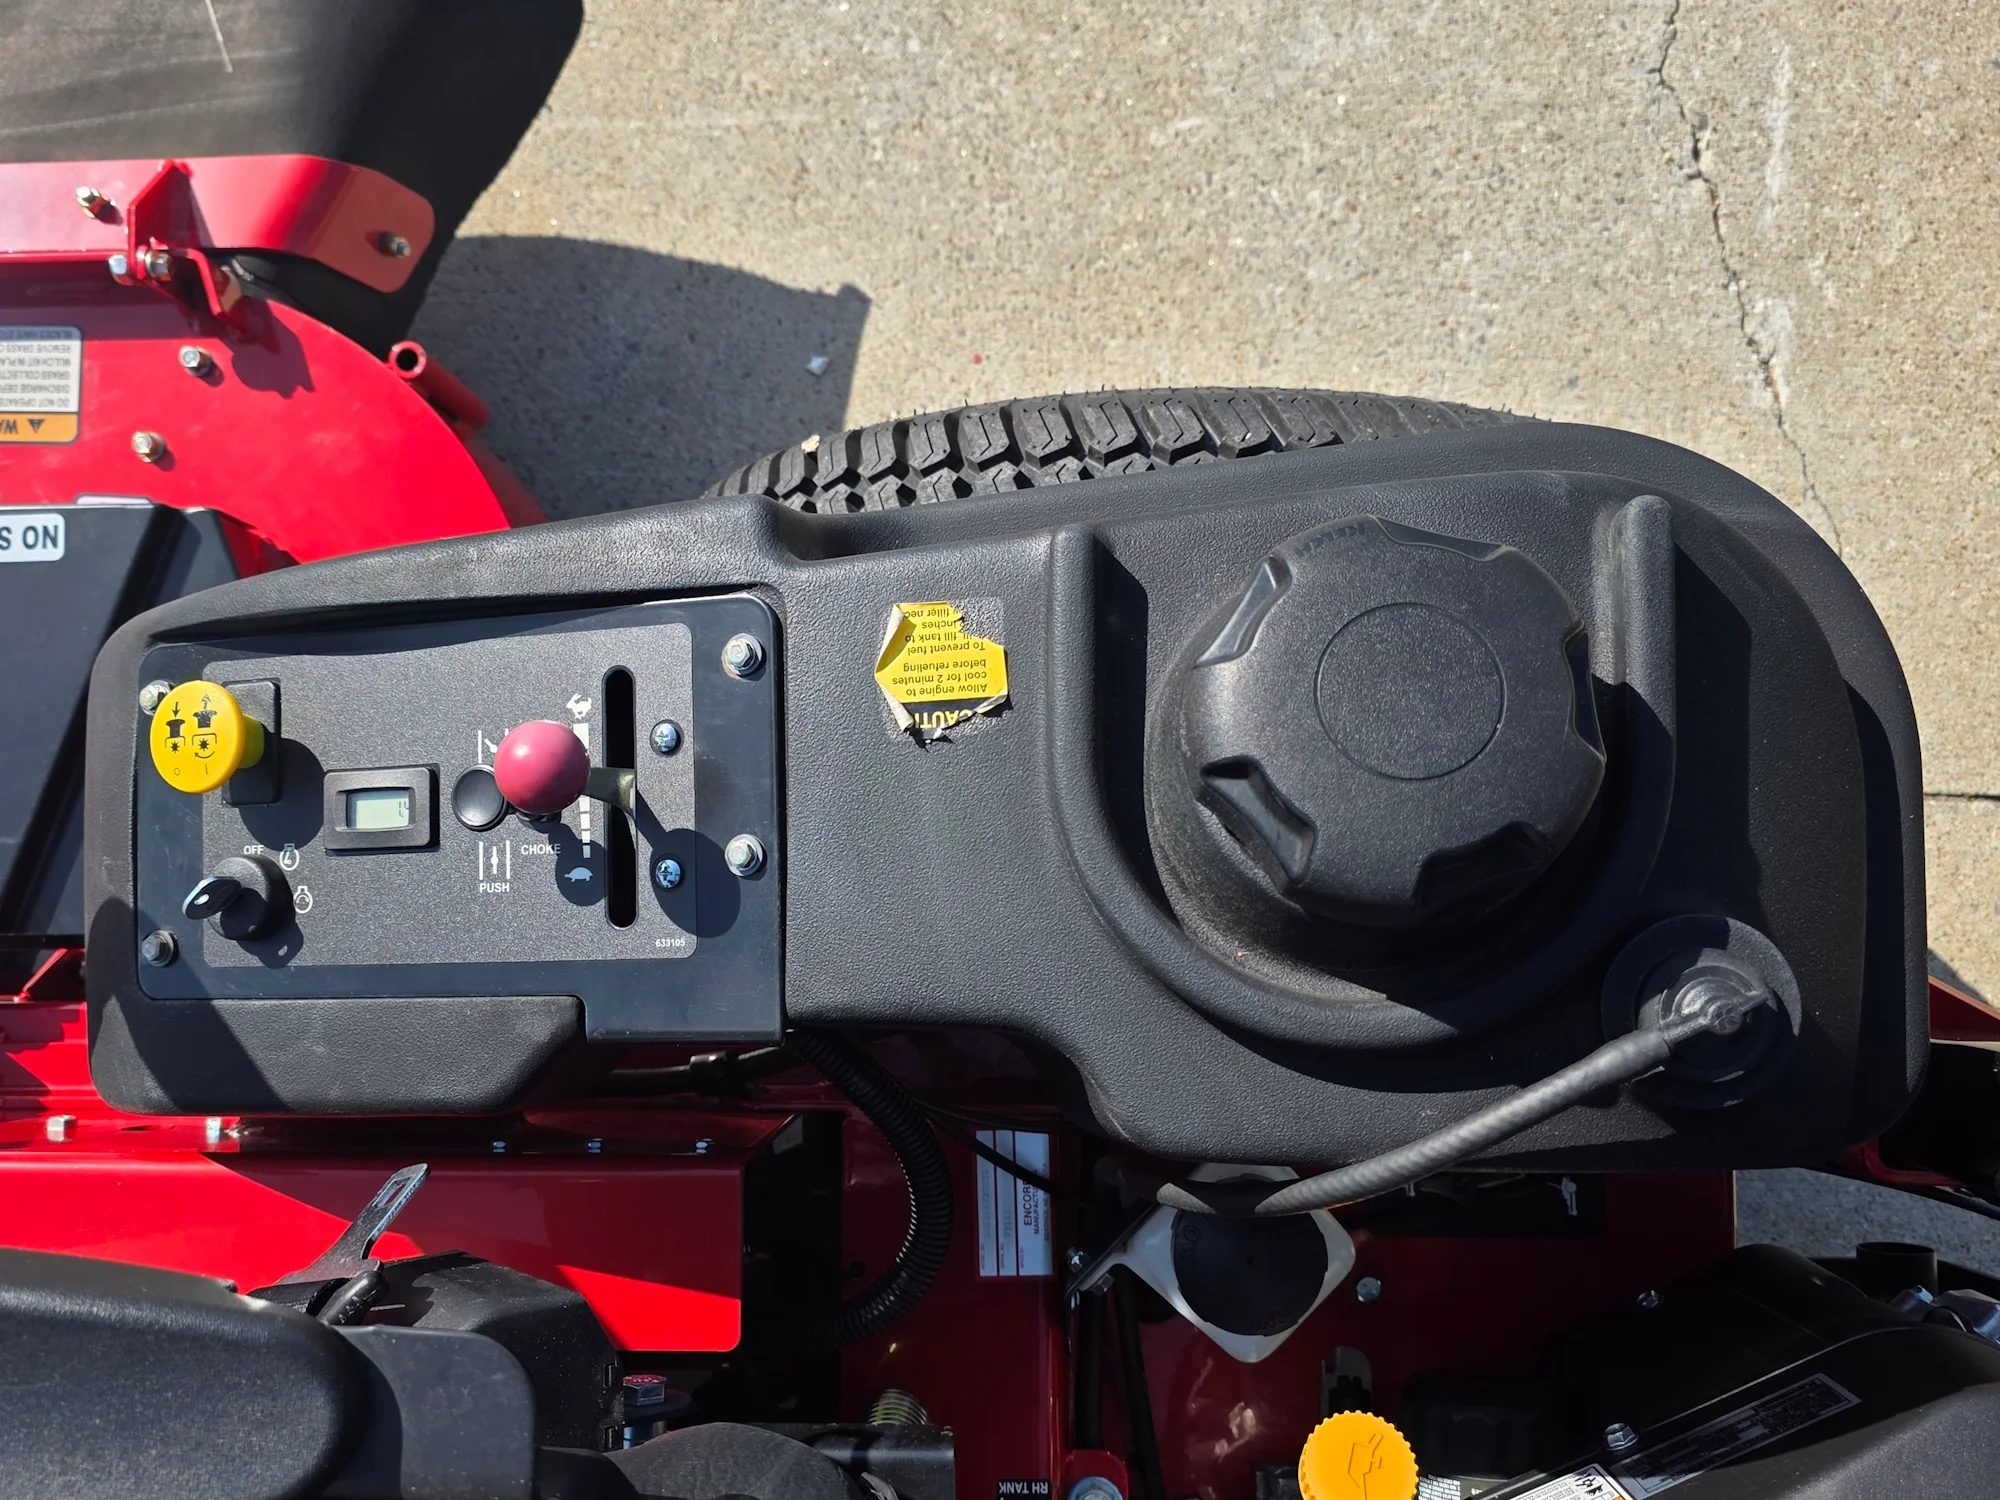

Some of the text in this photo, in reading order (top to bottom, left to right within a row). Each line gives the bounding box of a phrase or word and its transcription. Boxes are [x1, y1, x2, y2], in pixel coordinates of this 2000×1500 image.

[22, 525, 59, 550] NO
[903, 610, 923, 619] nec
[927, 608, 949, 618] filler
[921, 620, 956, 630] inches
[905, 635, 915, 643] to
[918, 633, 941, 642] tank
[944, 632, 957, 641] fill
[907, 641, 985, 656] To prevent fuel
[903, 659, 986, 674] before refueling
[892, 671, 987, 686] cool for 2 minutes
[906, 683, 987, 697] Allow engine to
[243, 845, 265, 855] OFF
[521, 843, 561, 855] CHOKE
[479, 883, 510, 893] PUSH
[655, 938, 685, 947] 633105
[998, 1482, 1048, 1494] RH TANK
